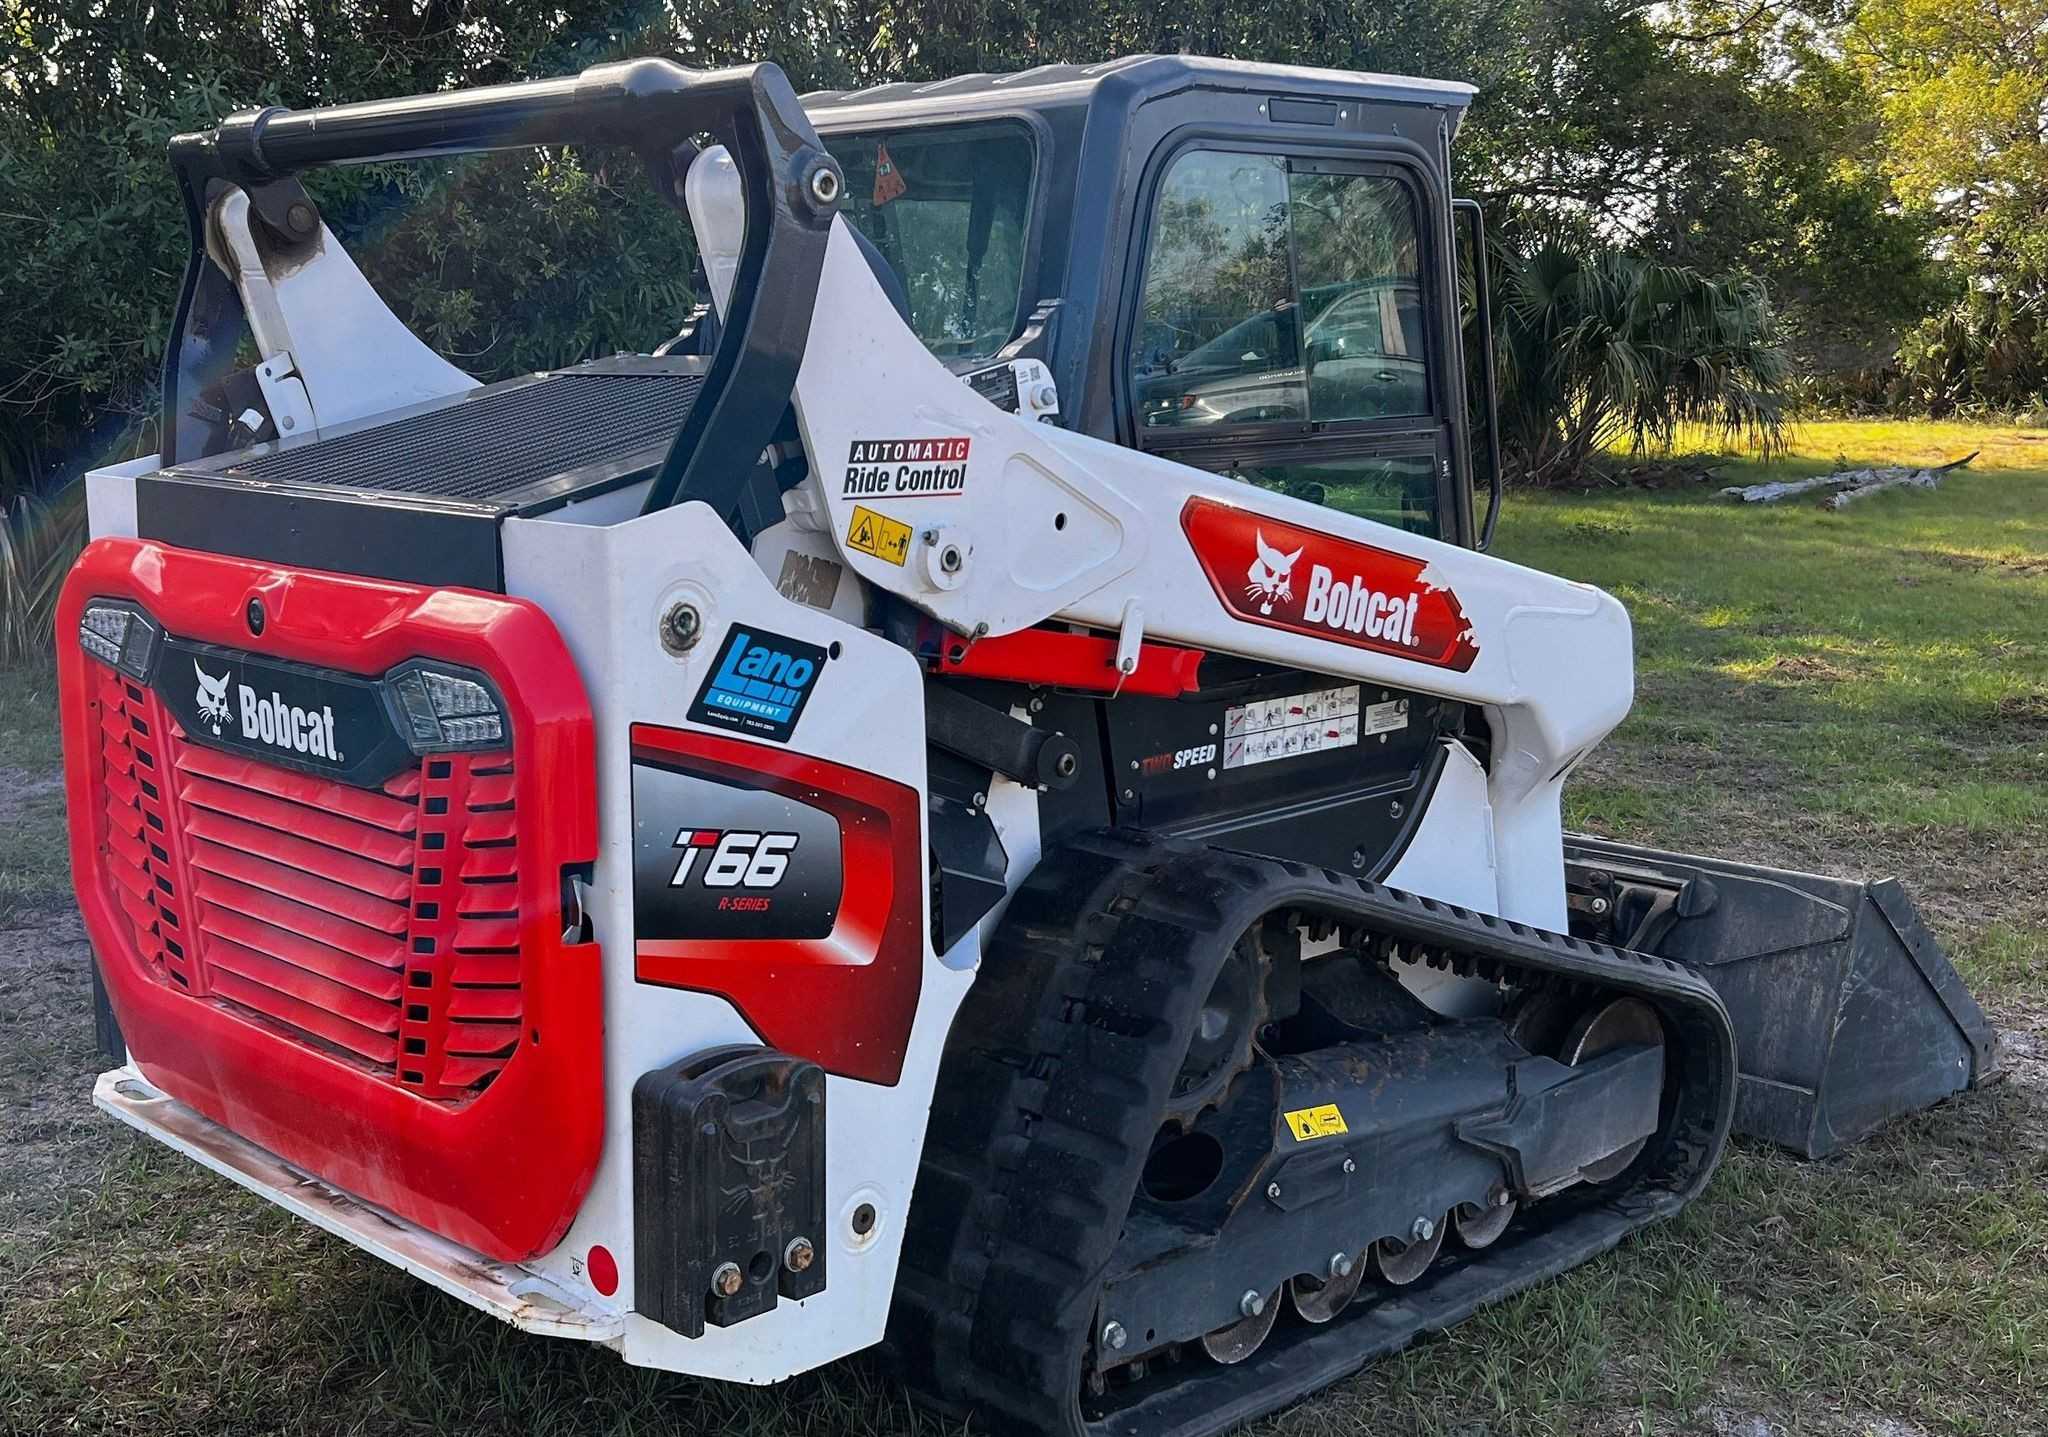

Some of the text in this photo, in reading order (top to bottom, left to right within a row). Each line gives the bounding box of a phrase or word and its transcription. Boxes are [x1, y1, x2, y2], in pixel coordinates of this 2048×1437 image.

[852, 441, 967, 461] AUTOMATIC
[843, 463, 967, 493] Ride Control
[1303, 564, 1419, 646] Bobcat
[712, 632, 814, 694] Lano
[716, 694, 781, 717] EQUIPMENT
[238, 684, 338, 761] Bobcat
[1173, 744, 1217, 769] SPEED
[671, 830, 799, 887] T66
[717, 896, 771, 911] R-SERIES
